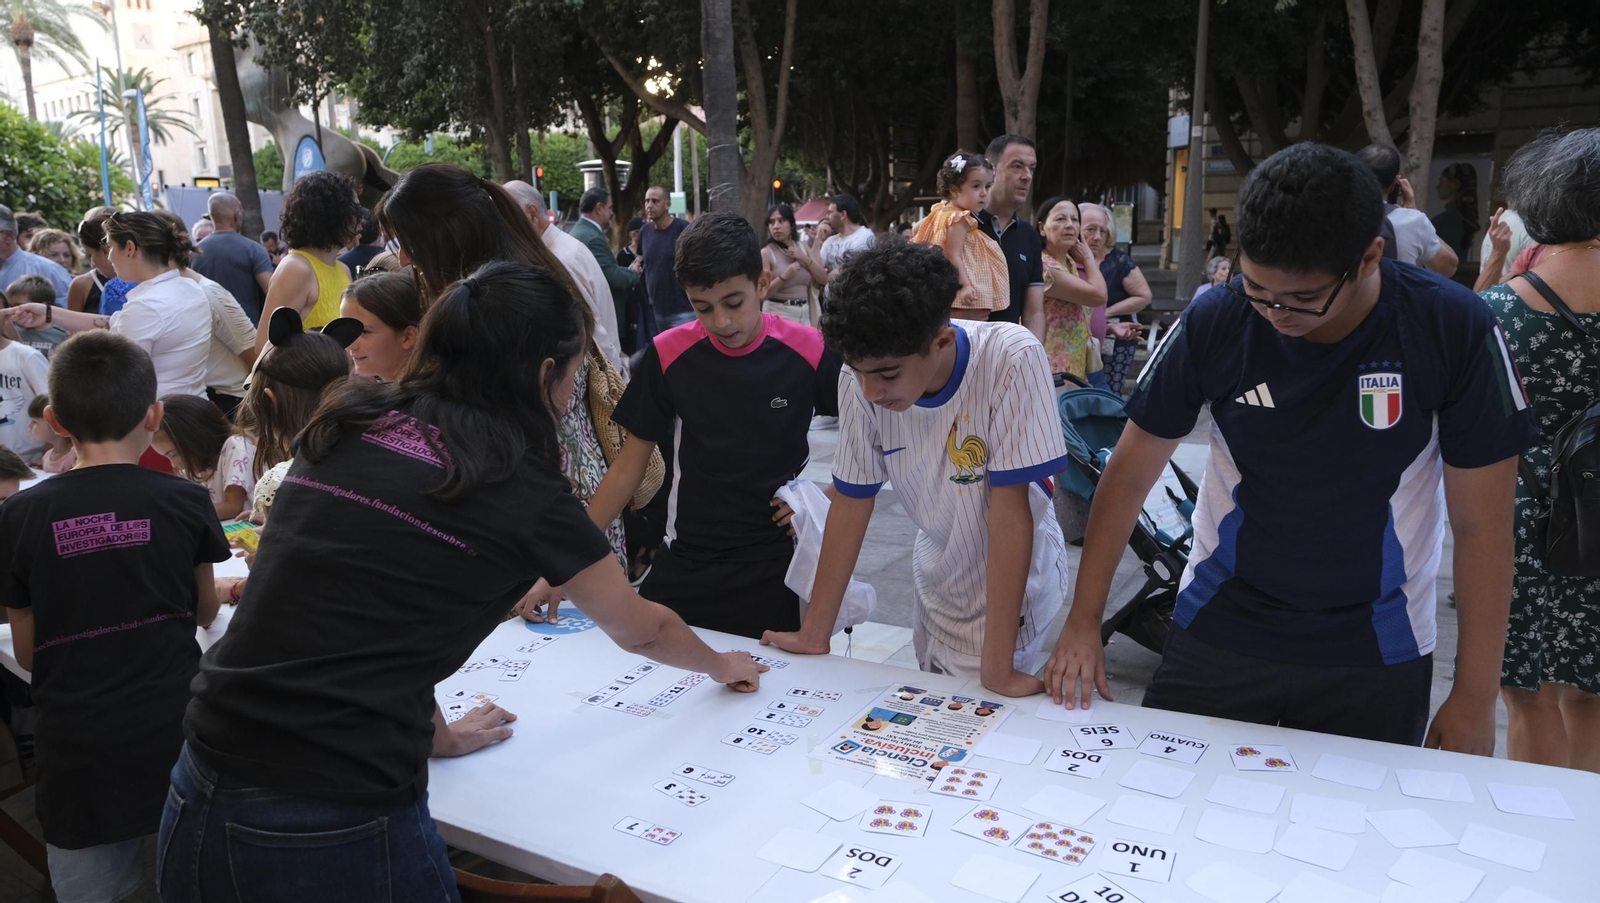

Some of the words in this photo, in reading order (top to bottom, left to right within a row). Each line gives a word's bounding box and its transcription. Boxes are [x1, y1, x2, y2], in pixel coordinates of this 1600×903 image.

[1361, 376, 1399, 388] ITALIA
[55, 521, 70, 531] LA
[75, 513, 113, 526] NOCHE
[57, 526, 106, 542] EUROPEA
[110, 522, 124, 532] DE
[126, 521, 148, 530] L@S
[60, 532, 148, 553] INVESTIGADOR@S
[748, 727, 767, 736] 10
[1080, 726, 1120, 735] SEIS
[1100, 738, 1114, 746] 6
[1150, 733, 1205, 749] CUATRO
[860, 738, 936, 760] inclusiva:
[1164, 746, 1177, 754] 4
[861, 746, 928, 768] Ciencia
[1060, 750, 1102, 763] DOS
[682, 766, 694, 774] 6
[1067, 763, 1080, 772] 2
[626, 822, 640, 830] 7
[1112, 842, 1166, 860] UNO
[846, 848, 892, 868] DOS
[846, 867, 863, 878] 2
[1129, 862, 1141, 872] 1
[1093, 886, 1124, 903] 10
